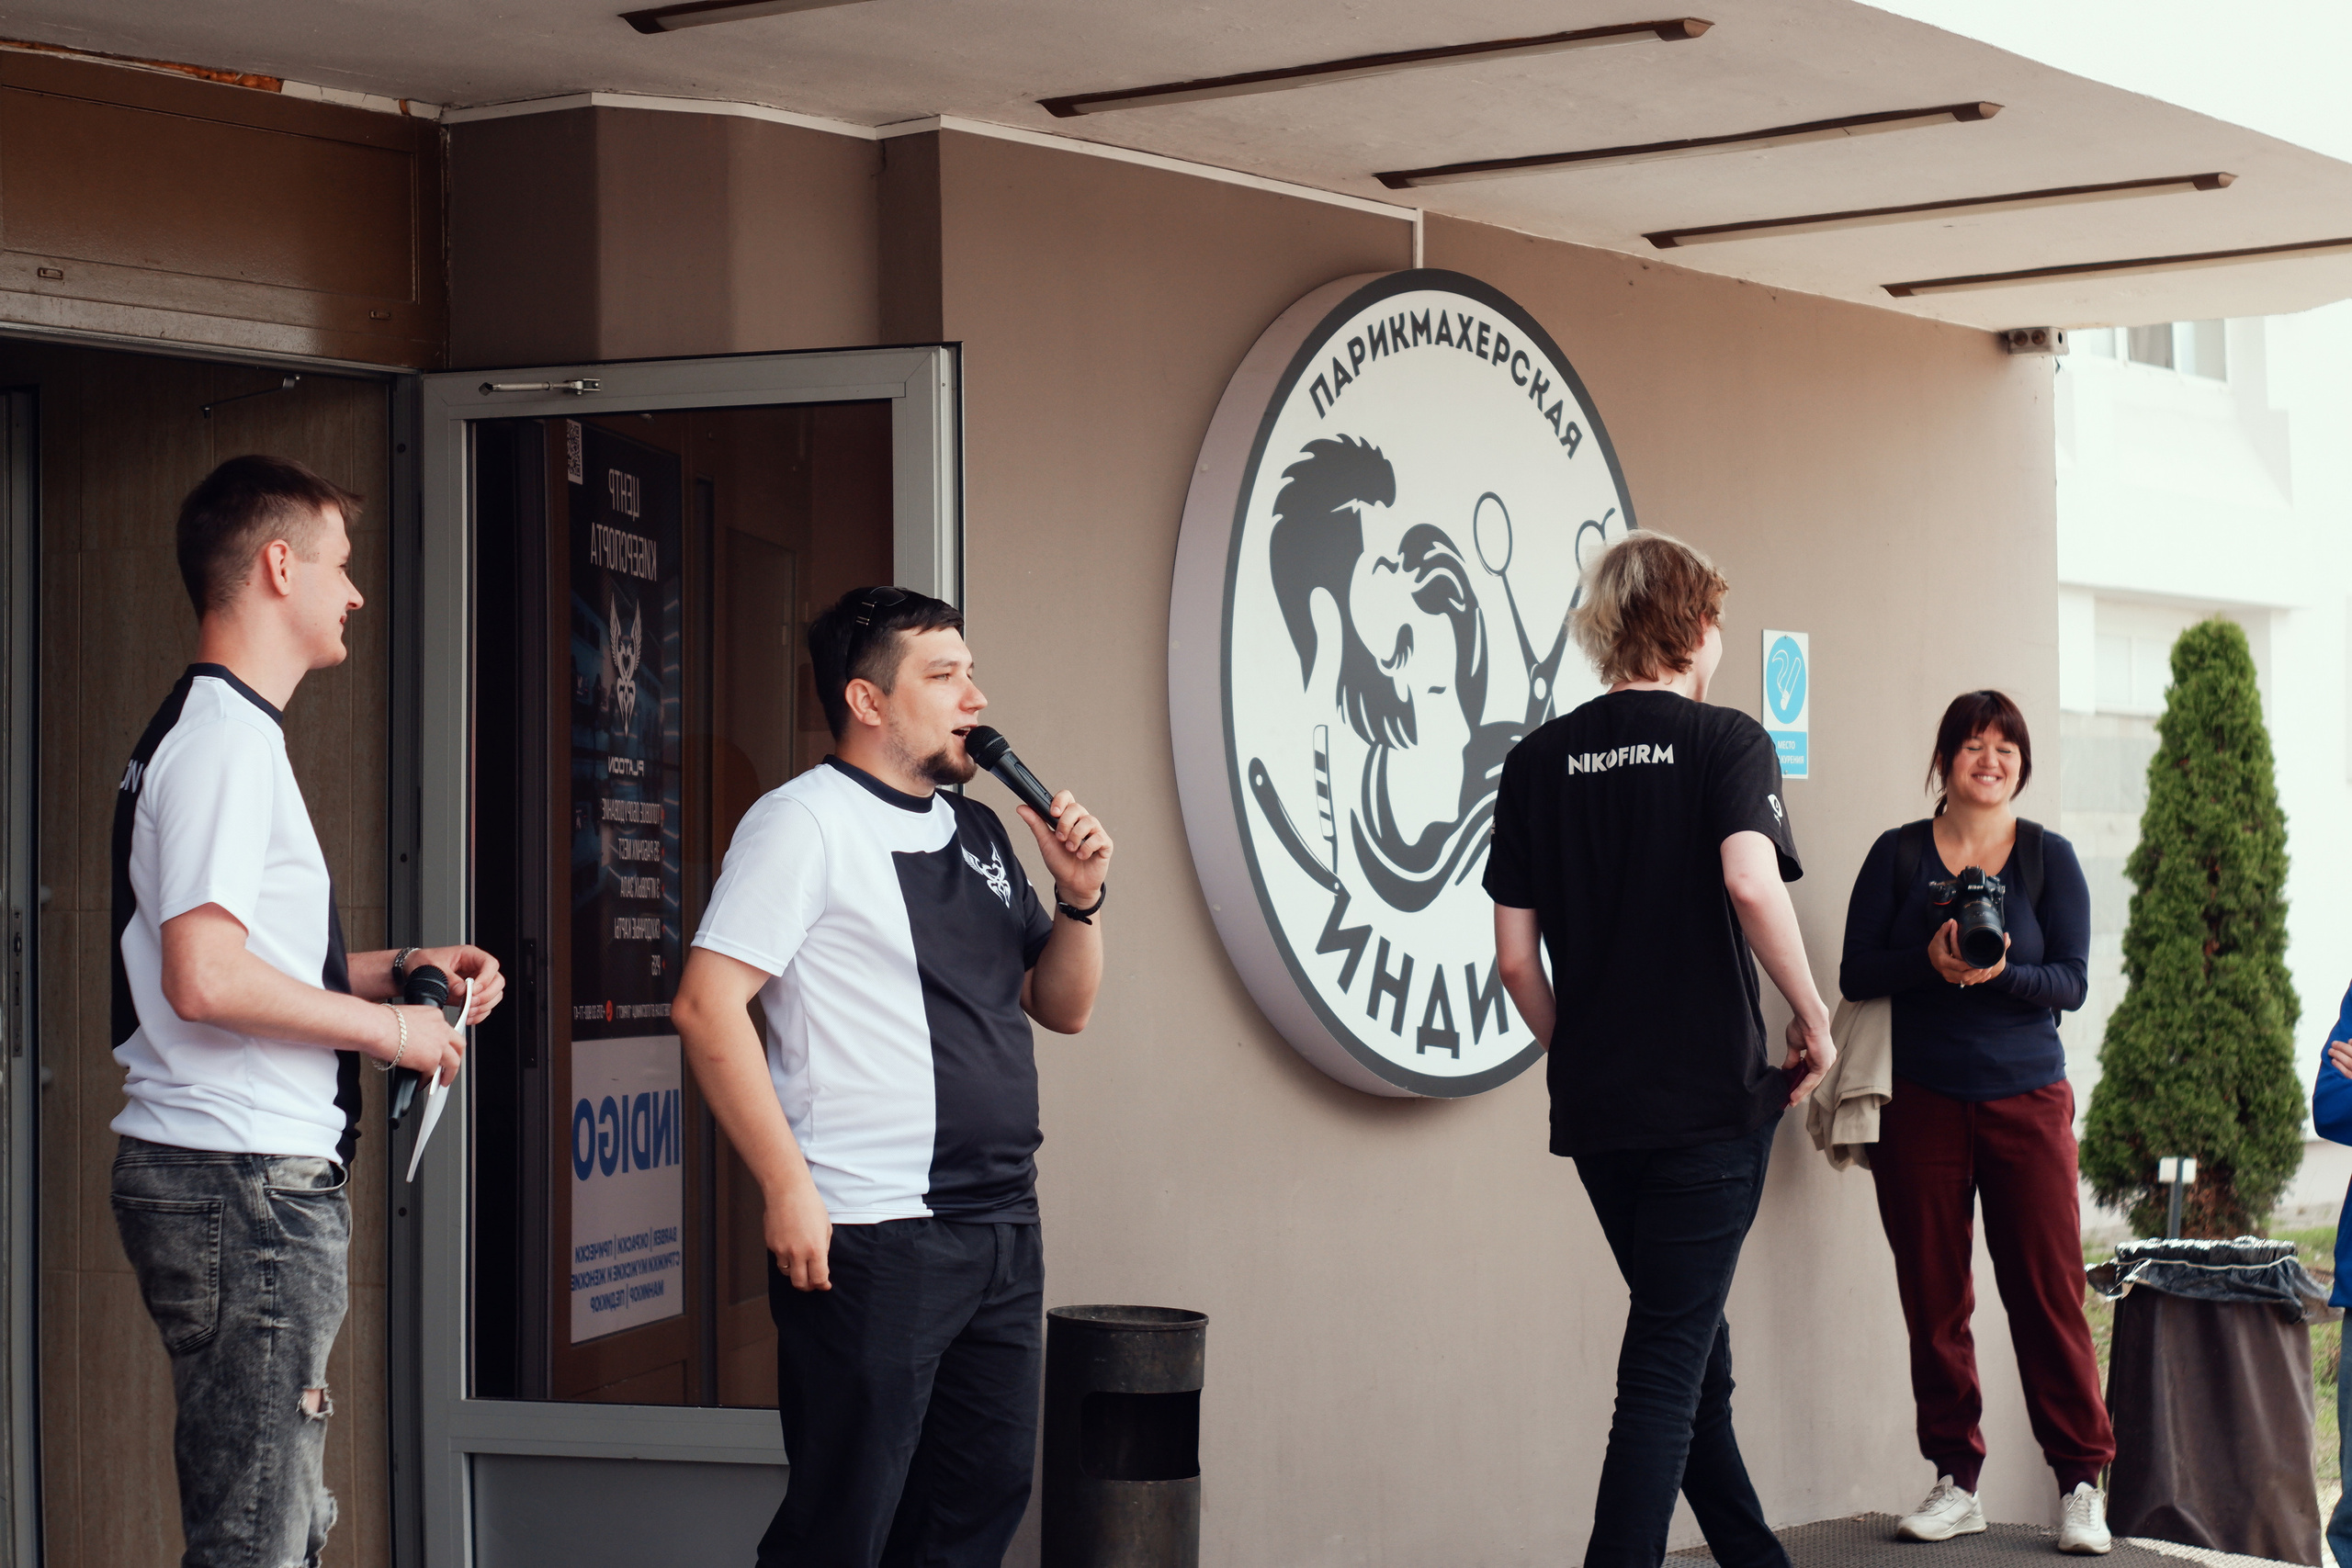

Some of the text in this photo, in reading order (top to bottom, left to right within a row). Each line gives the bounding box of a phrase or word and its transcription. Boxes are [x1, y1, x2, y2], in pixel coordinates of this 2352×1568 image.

[1308, 308, 1583, 459] ПАРИКМАХЕРСКАЯ
[1568, 743, 1675, 775] NIKOFIRM
[1777, 740, 1795, 750] МЕСТО
[1781, 755, 1804, 764] КУРЕНИЯ
[1316, 893, 1509, 1059] ИНДИ
